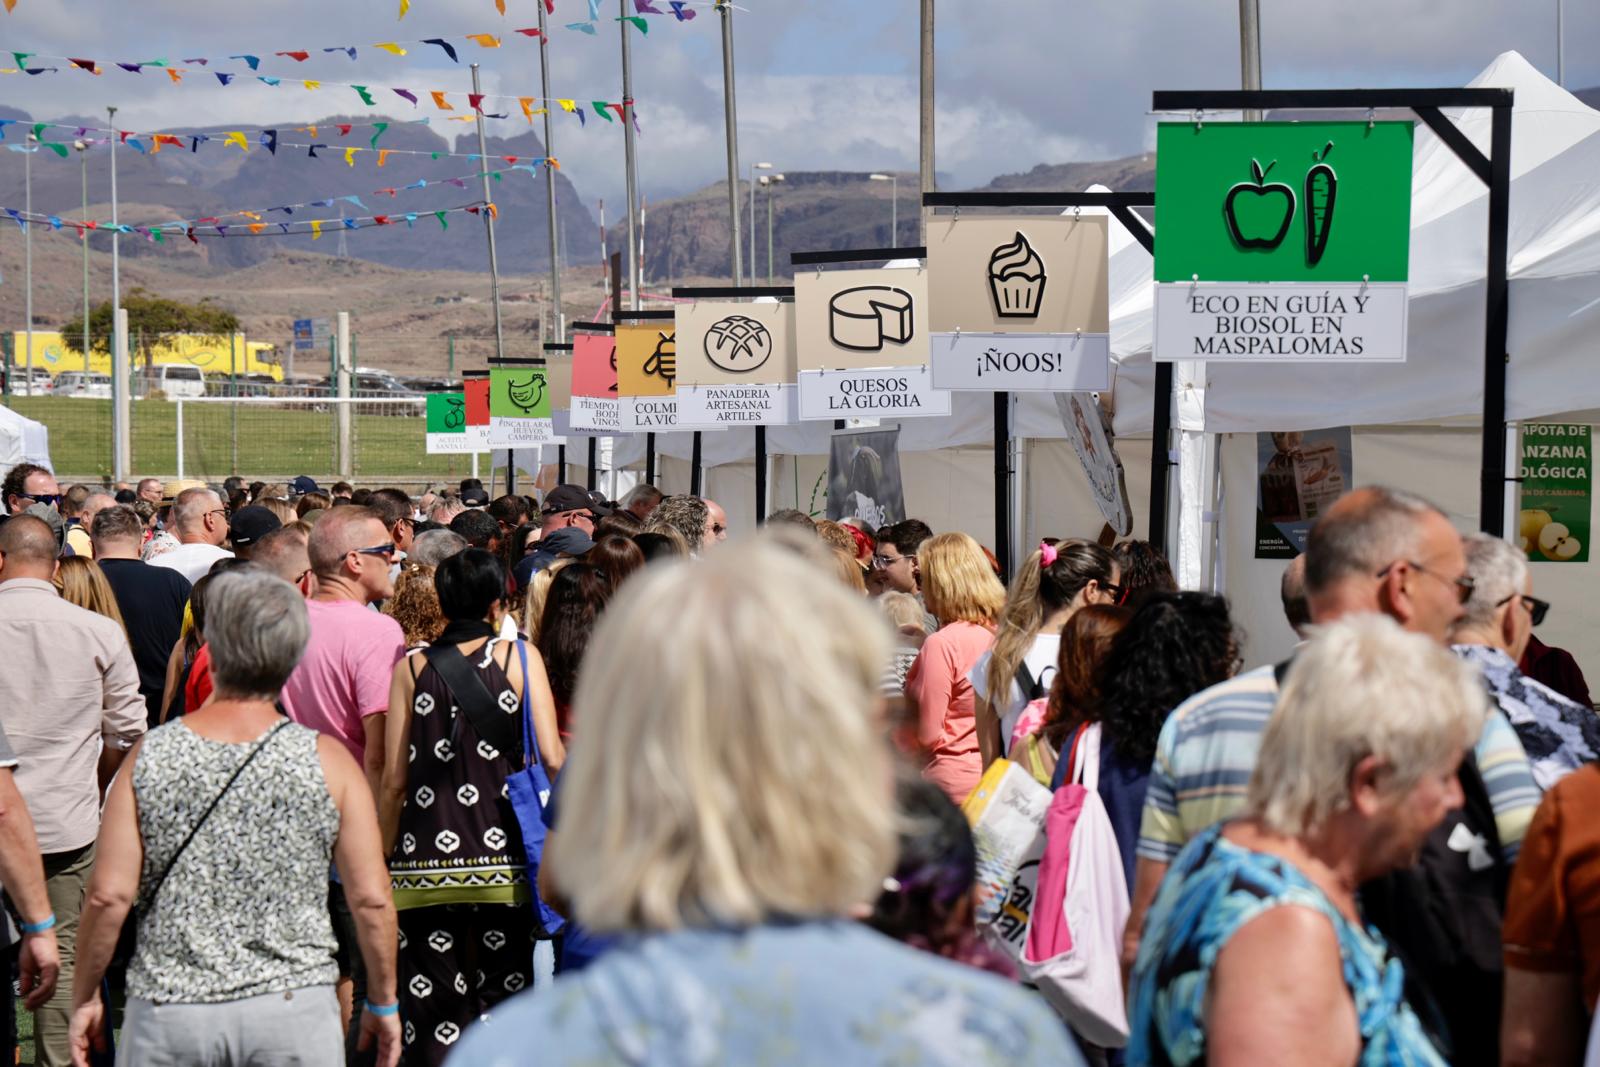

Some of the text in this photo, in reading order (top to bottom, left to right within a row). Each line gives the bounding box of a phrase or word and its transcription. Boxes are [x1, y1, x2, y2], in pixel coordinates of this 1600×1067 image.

[1191, 291, 1370, 313] ECO EN GUÍA Y
[1215, 316, 1343, 334] BIOSOL EN
[1193, 336, 1364, 355] MASPALOMAS
[977, 348, 1062, 377] ¡ÑOOS!
[840, 378, 908, 396] QUESOS
[706, 389, 770, 398] PANADERIA
[580, 401, 615, 410] TIEMPO
[705, 400, 772, 409] ARTESANAL
[829, 394, 921, 409] LA GLORIA
[635, 415, 652, 425] LA
[716, 411, 762, 421] ARTILES
[592, 417, 620, 426] VINOS
[1568, 426, 1587, 436] DE
